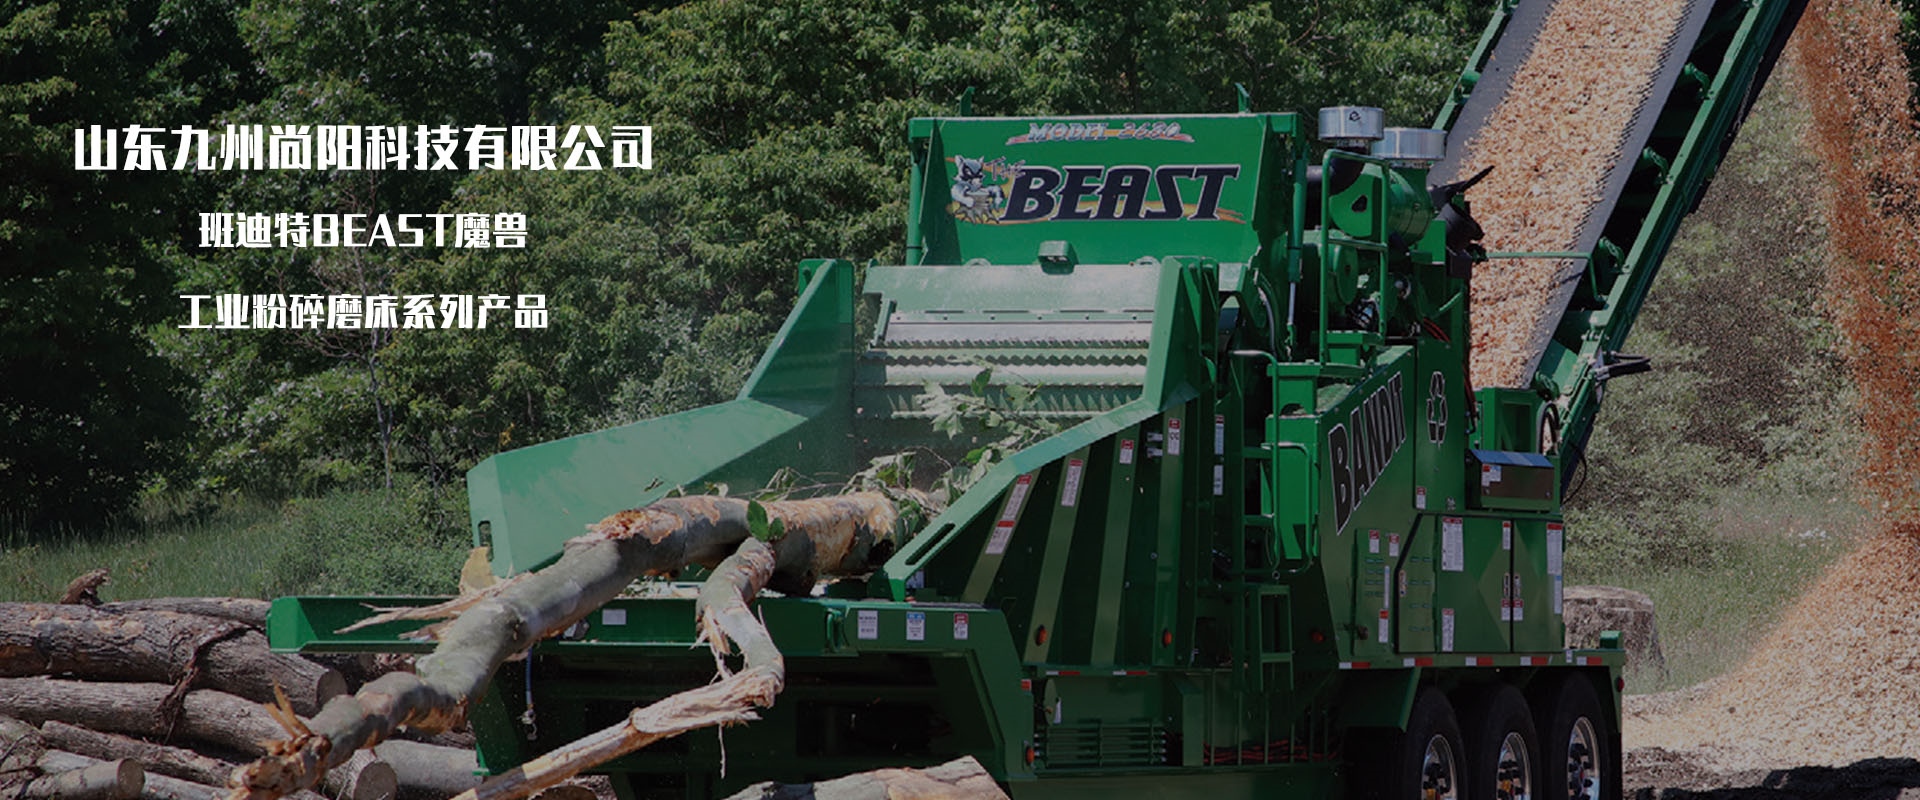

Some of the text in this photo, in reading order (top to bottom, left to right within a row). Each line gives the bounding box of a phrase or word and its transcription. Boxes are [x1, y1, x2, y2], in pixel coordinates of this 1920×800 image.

[1028, 122, 1108, 142] MODEL
[1000, 164, 1241, 222] BEAST
[1327, 371, 1407, 536] BANDIT
